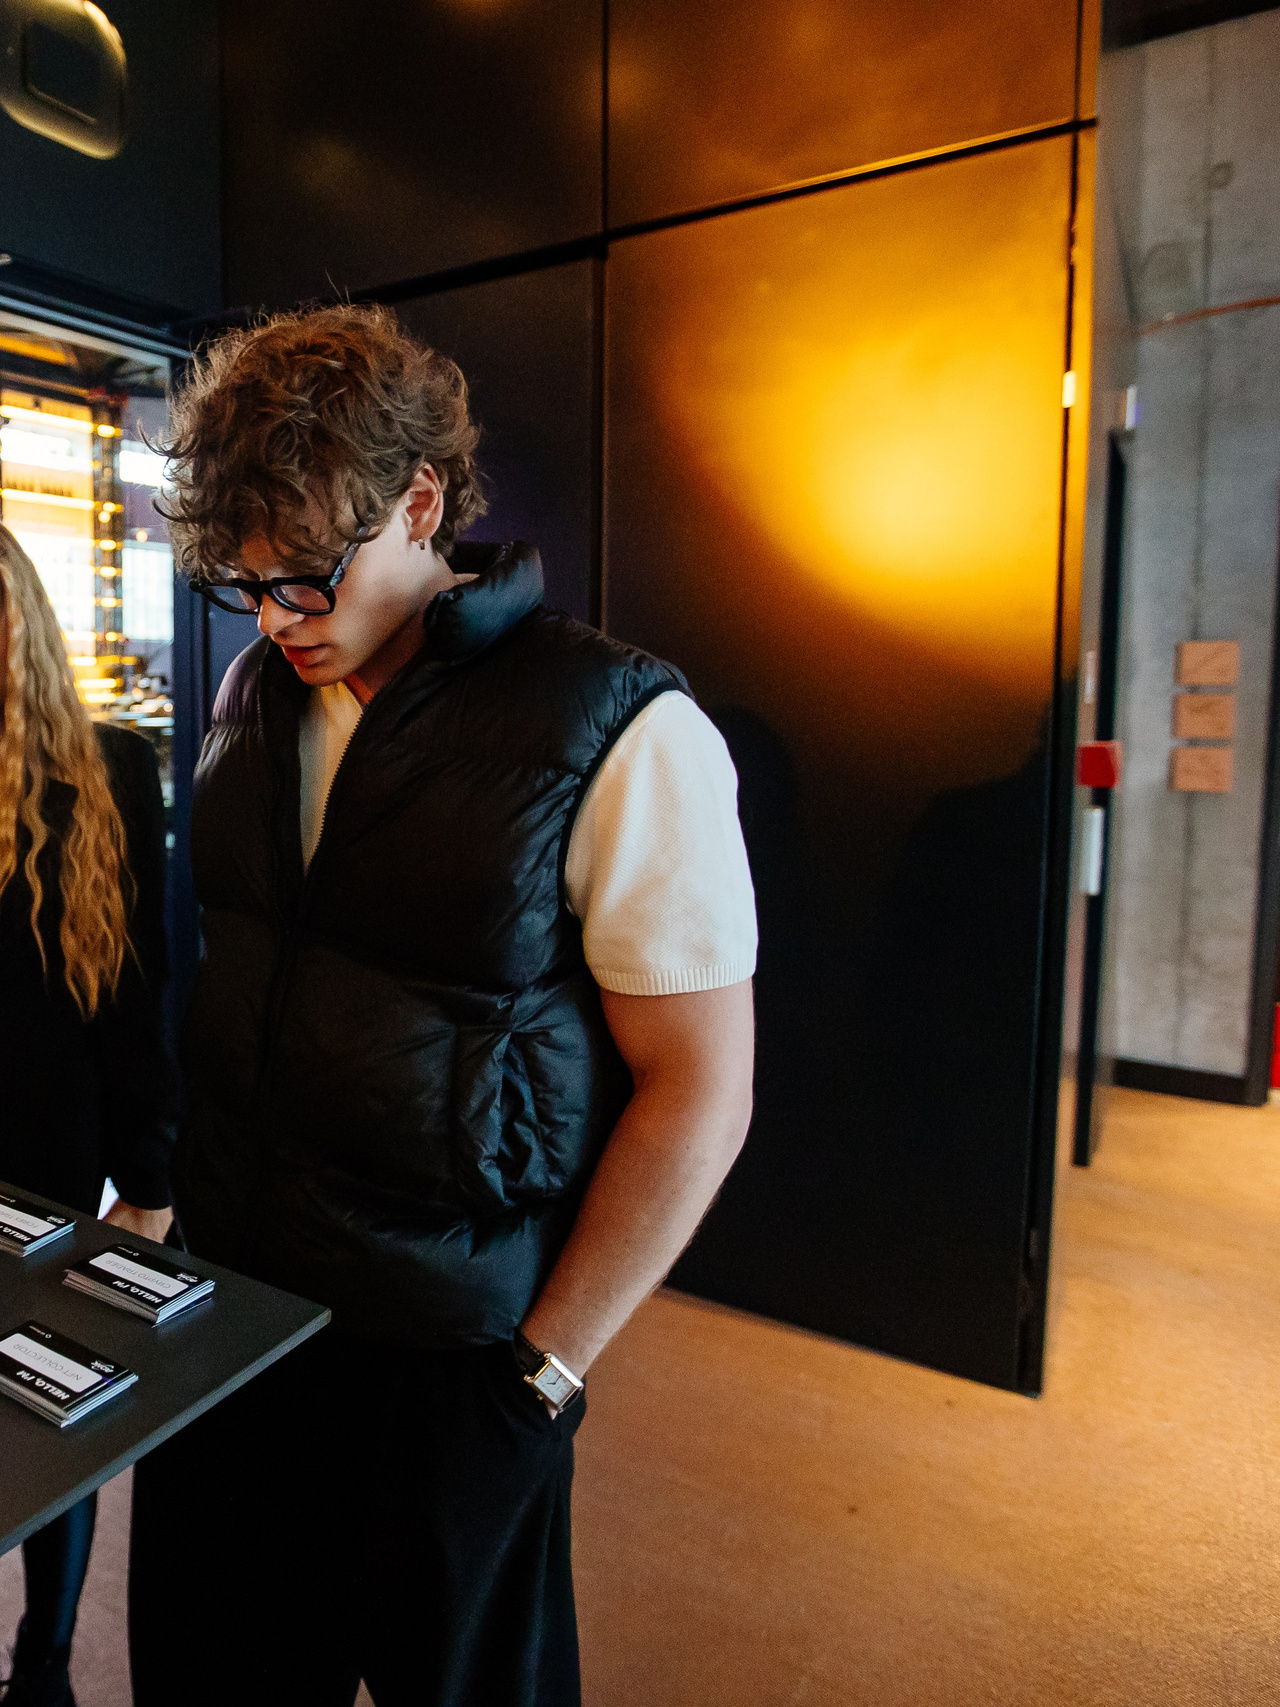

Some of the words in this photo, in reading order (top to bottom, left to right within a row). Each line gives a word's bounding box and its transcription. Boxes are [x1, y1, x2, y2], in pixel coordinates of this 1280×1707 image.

[2, 1226, 31, 1242] HELLO,
[105, 1258, 138, 1276] TRADER
[112, 1280, 130, 1289] I'M
[138, 1272, 171, 1289] CRYPTO
[130, 1286, 162, 1303] HELLO,
[12, 1343, 63, 1372] COLLECTOR
[16, 1370, 35, 1381] I'M
[63, 1367, 82, 1381] NFT
[35, 1378, 70, 1400] HELLO,
